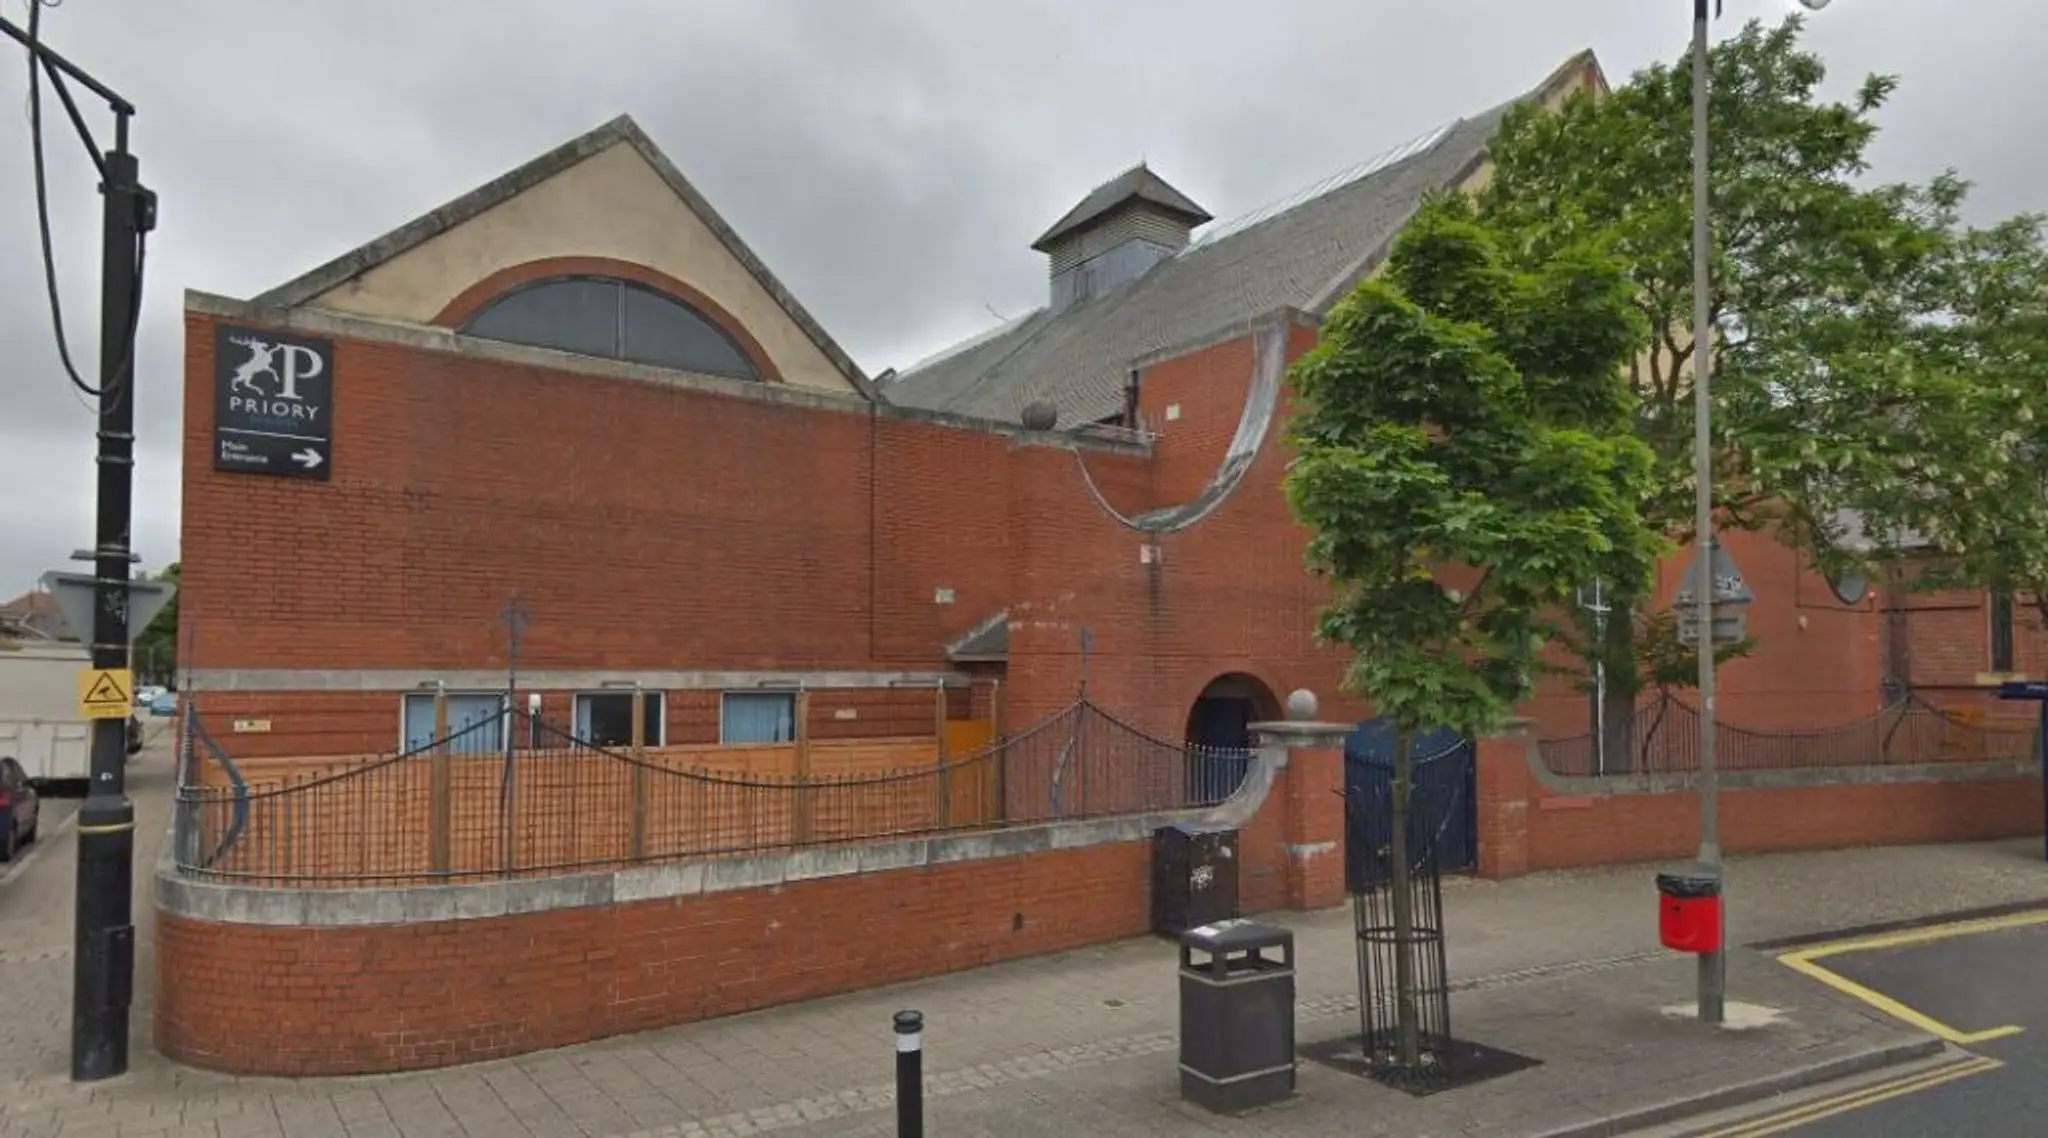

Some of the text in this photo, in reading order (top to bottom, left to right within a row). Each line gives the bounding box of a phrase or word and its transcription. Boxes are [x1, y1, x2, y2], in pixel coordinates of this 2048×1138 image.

[275, 343, 323, 400] P
[229, 396, 319, 420] PRIORY
[222, 440, 248, 451] Main
[222, 450, 269, 464] Entrance
